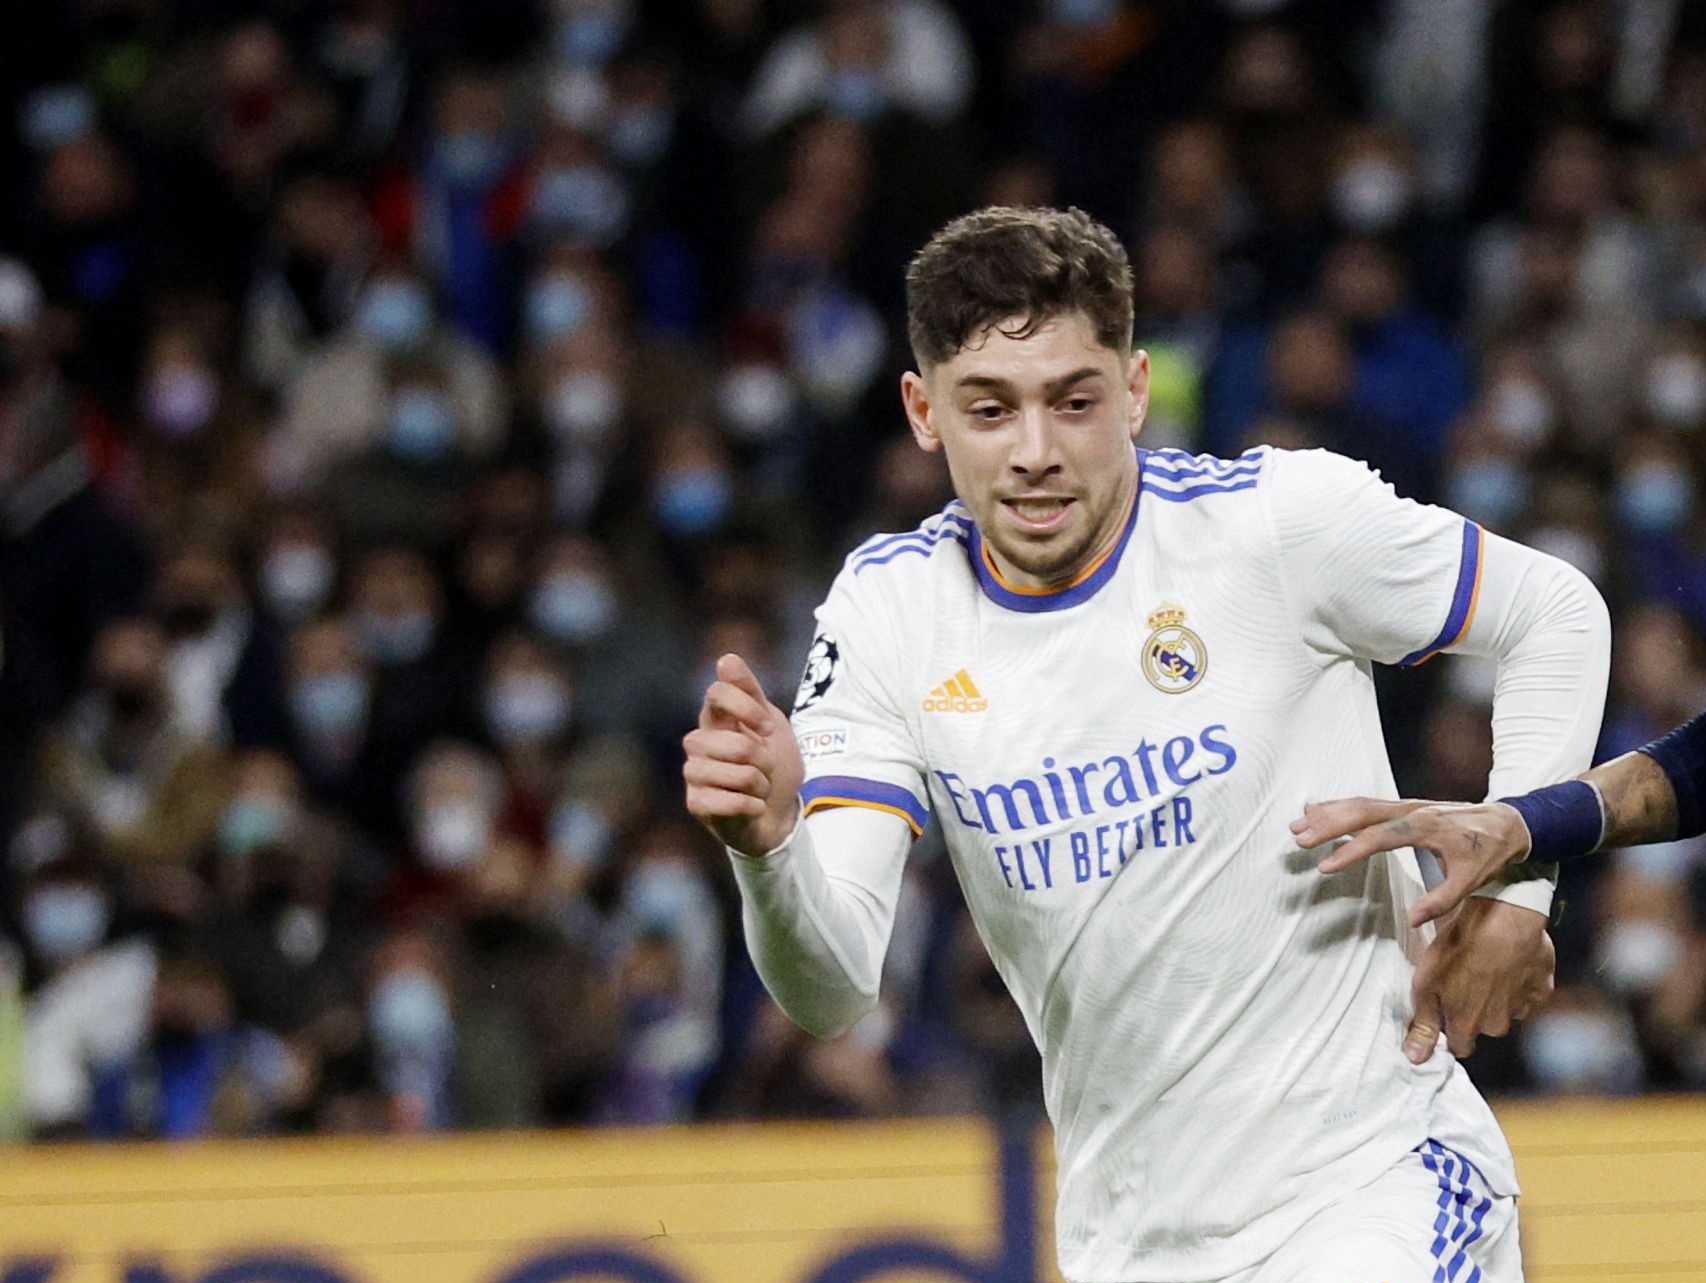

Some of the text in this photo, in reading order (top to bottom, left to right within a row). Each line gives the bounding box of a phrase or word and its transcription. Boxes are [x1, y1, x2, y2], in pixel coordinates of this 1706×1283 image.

[922, 696, 988, 713] adidas
[800, 733, 846, 748] TION
[935, 725, 1237, 834] Emirates
[995, 796, 1196, 890] FLY BETTER
